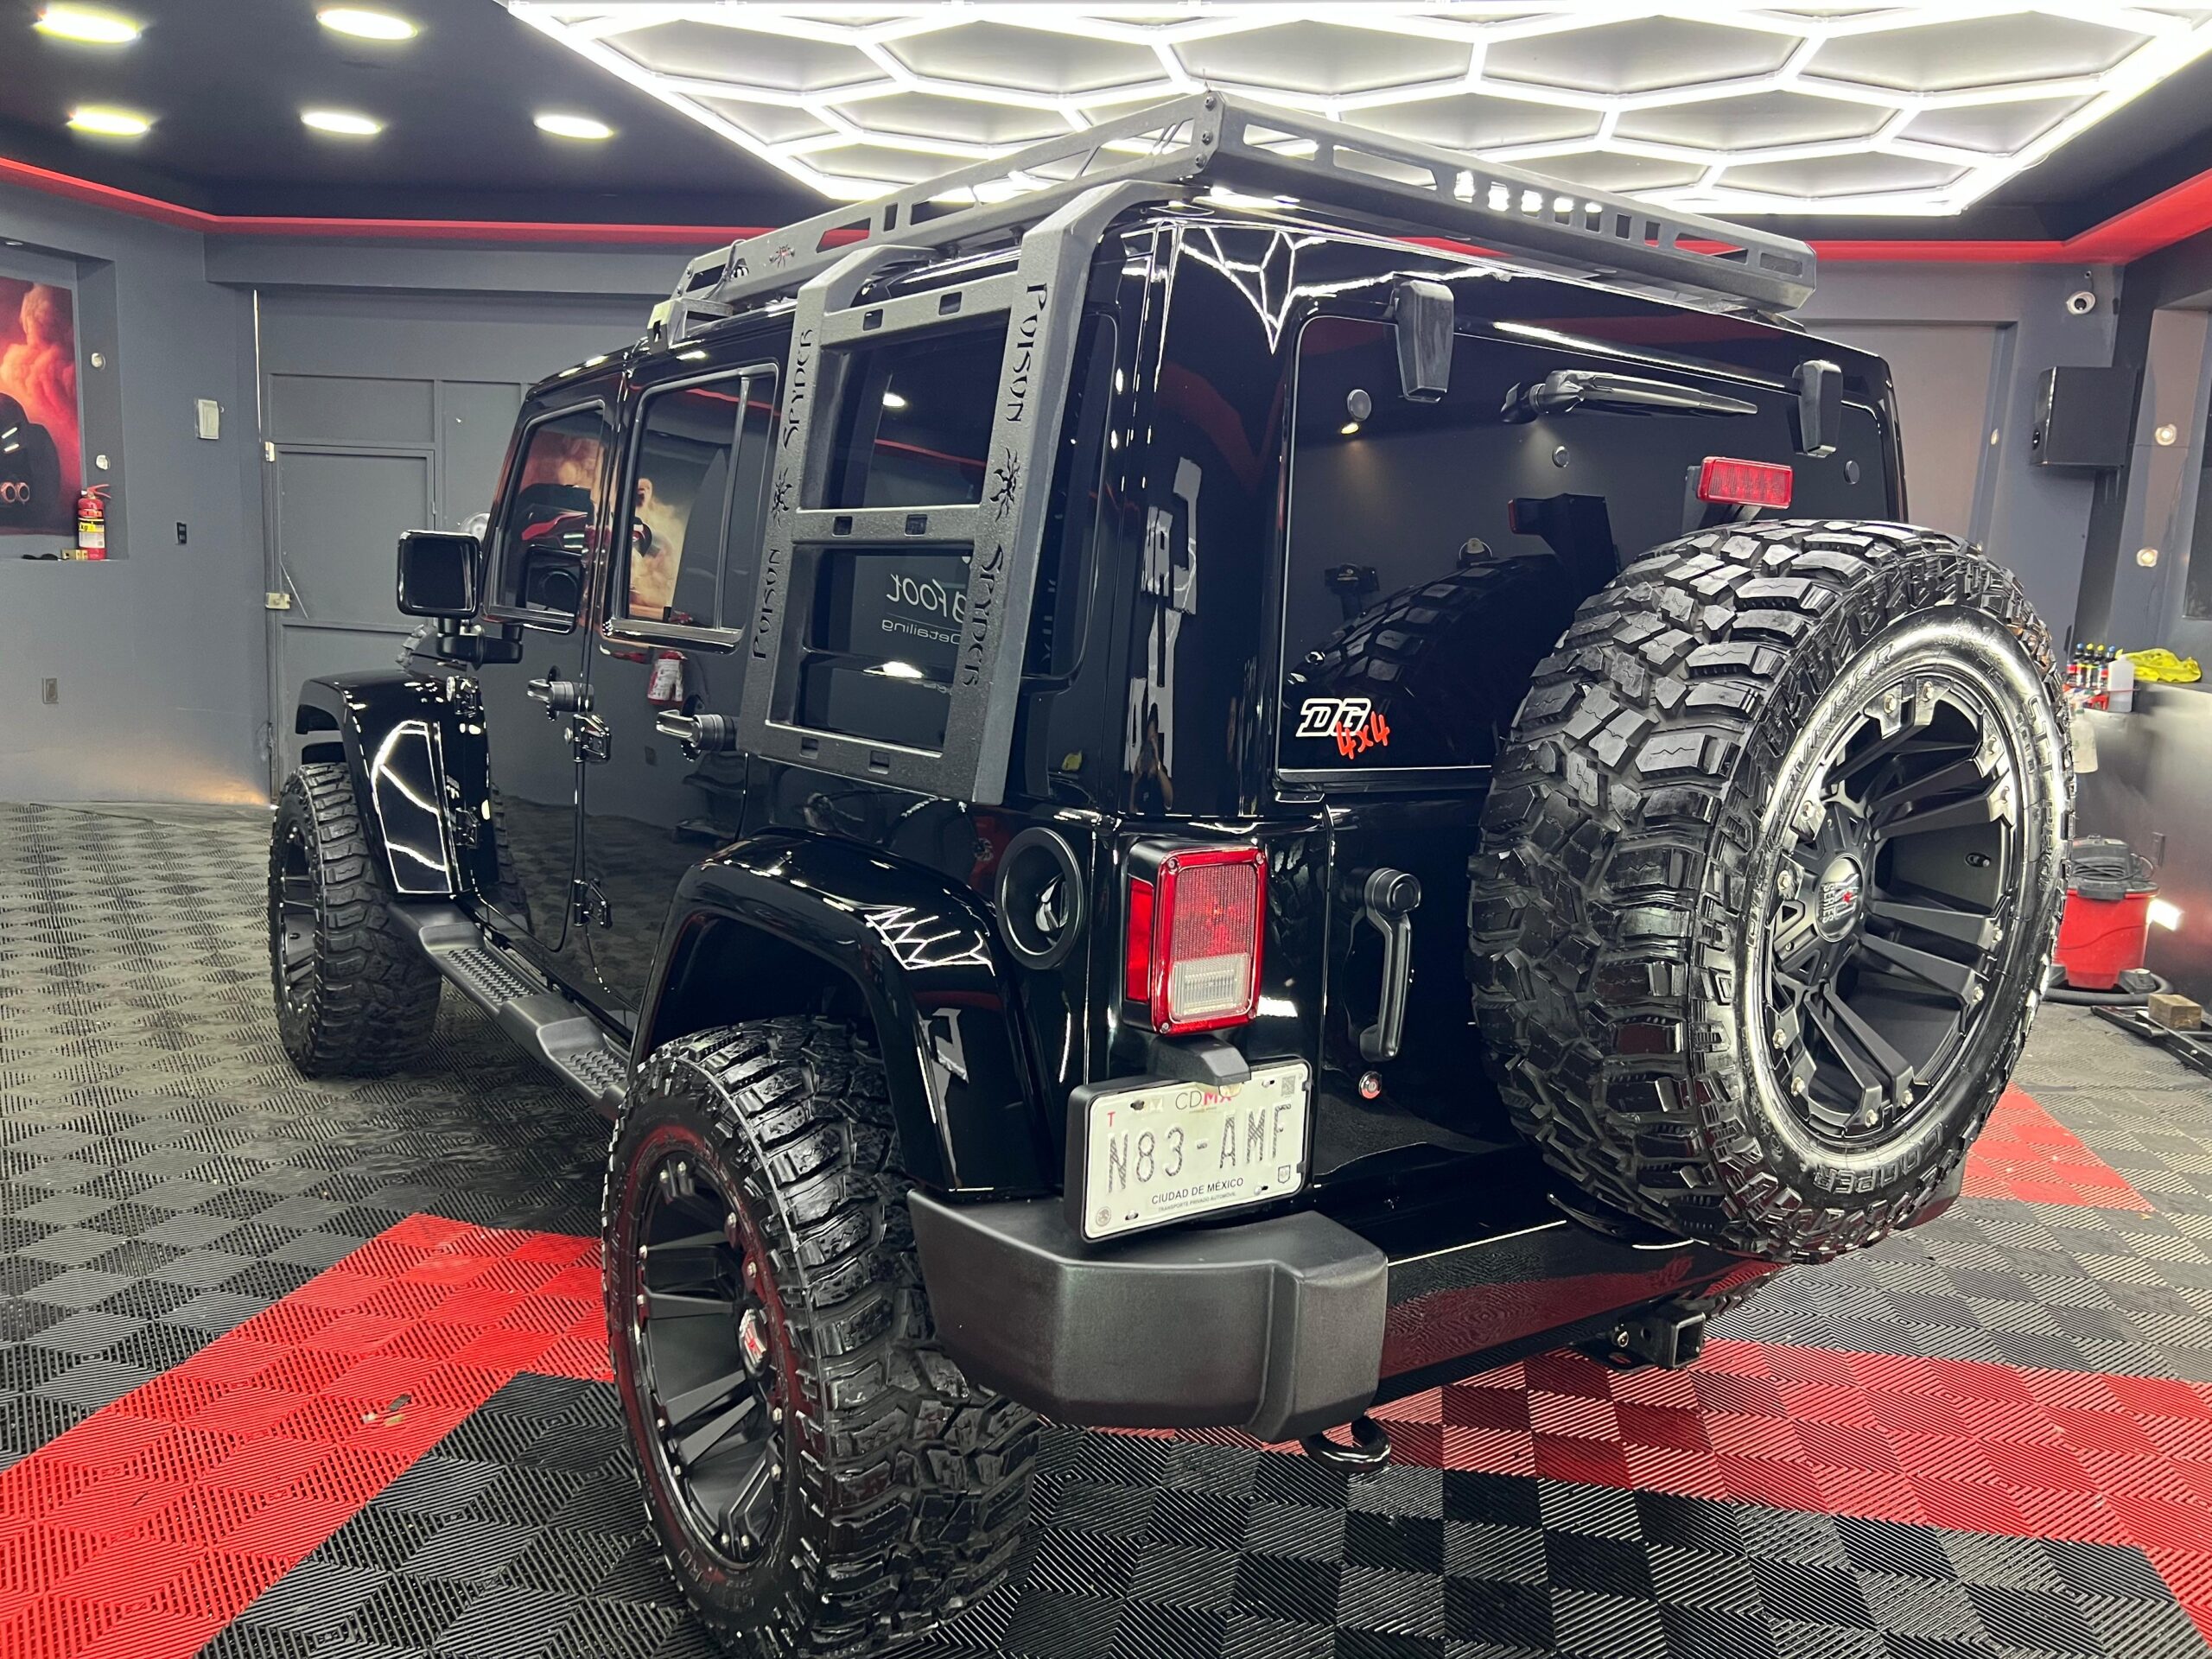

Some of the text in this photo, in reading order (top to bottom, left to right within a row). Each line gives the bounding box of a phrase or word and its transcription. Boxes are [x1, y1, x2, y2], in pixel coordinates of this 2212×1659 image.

[753, 329, 813, 659] POISON SPYDER
[962, 283, 1047, 687] POISON SPYDER
[1336, 711, 1389, 760] 4x4
[1821, 883, 1837, 924] SERIES
[1107, 1111, 1116, 1127] T
[1813, 1122, 1943, 1194] COOPER
[1151, 1177, 1244, 1205] CIUDAD DE MÉXICO
[1159, 1201, 1189, 1211] TRANSPORTE
[1189, 1196, 1211, 1205] PRIVADO
